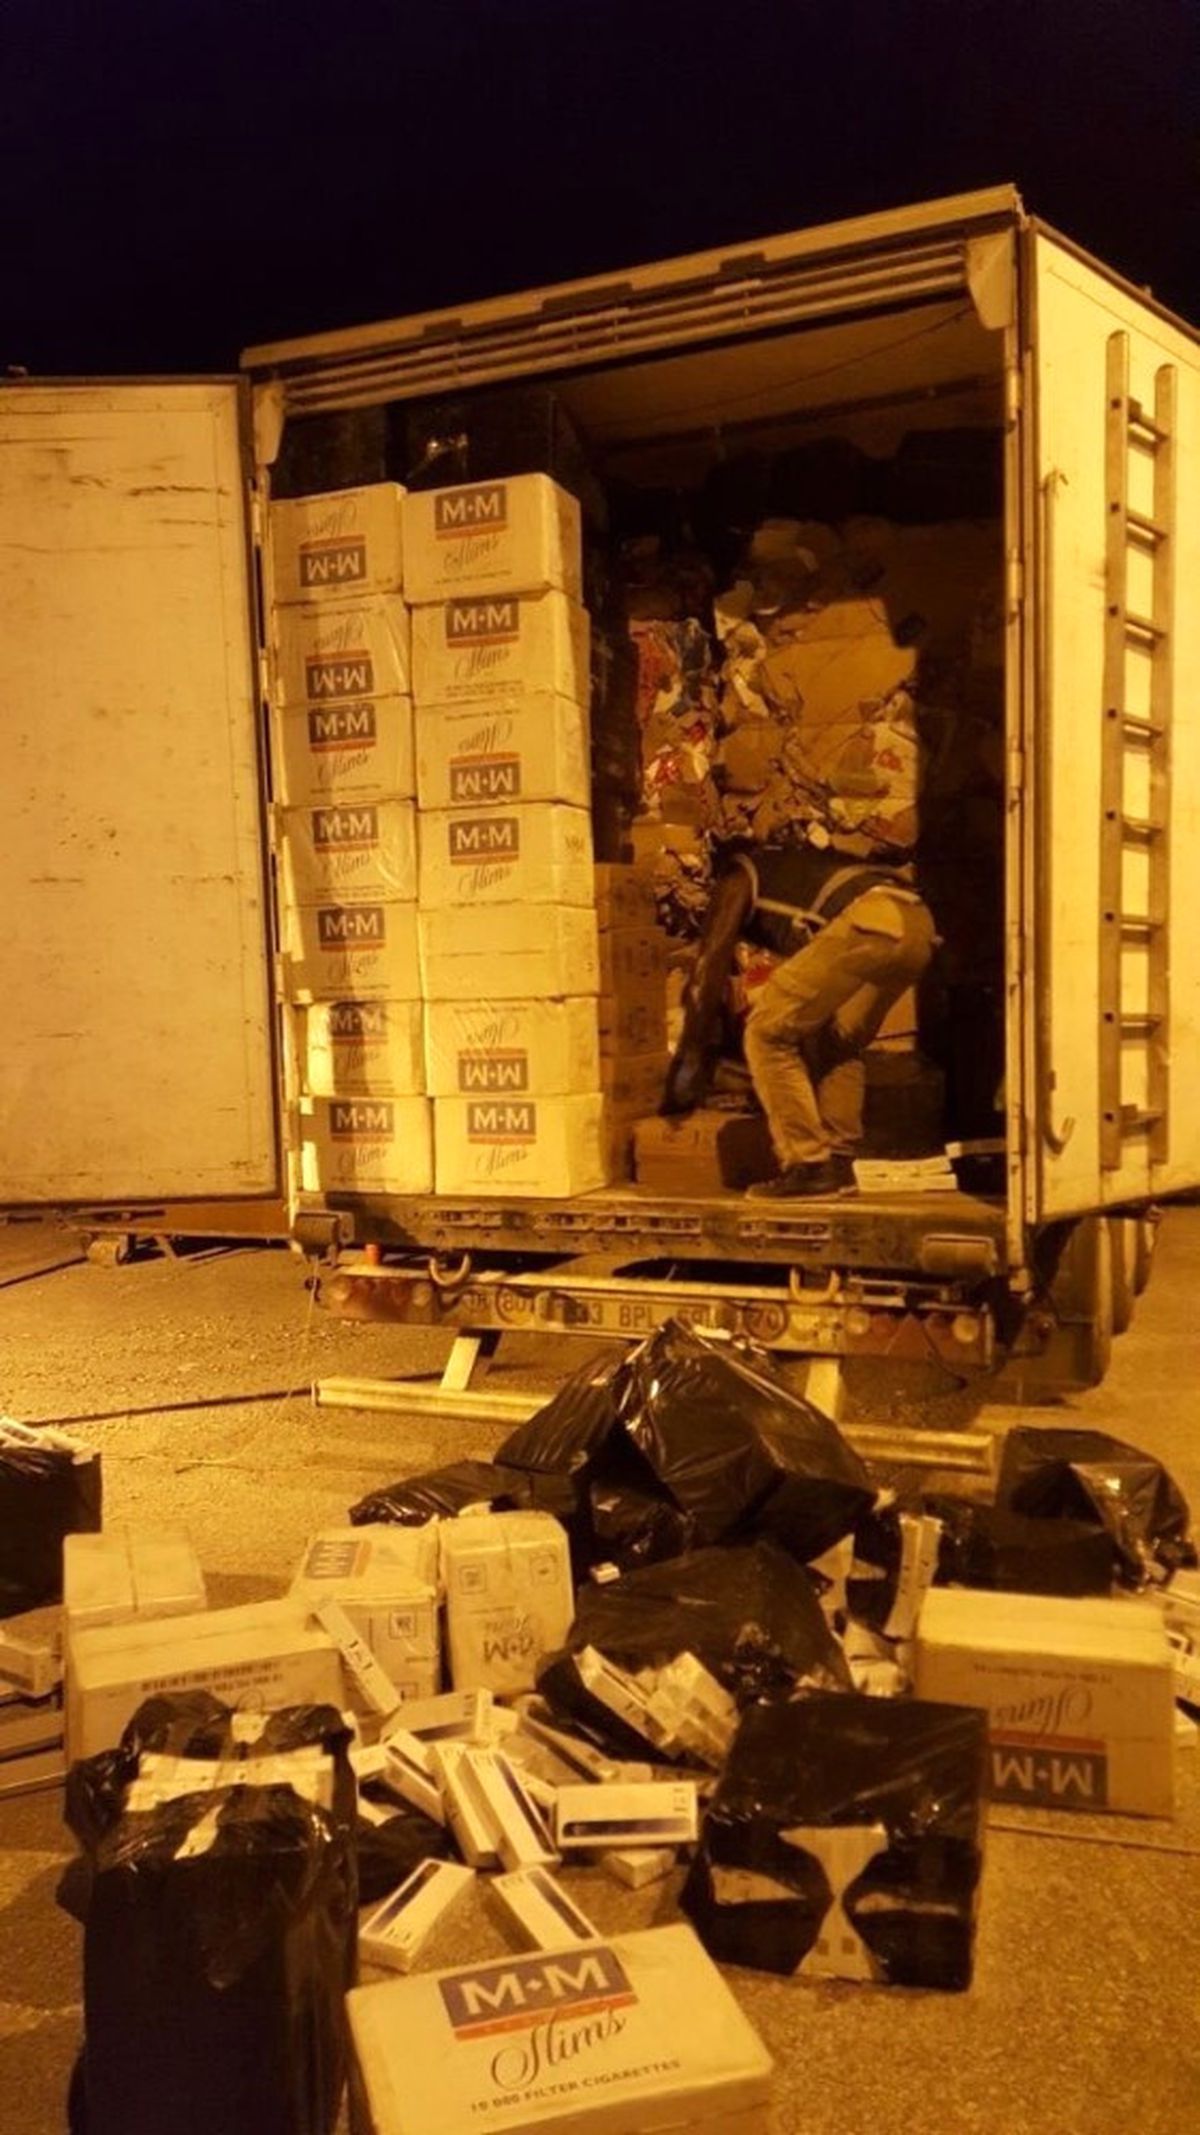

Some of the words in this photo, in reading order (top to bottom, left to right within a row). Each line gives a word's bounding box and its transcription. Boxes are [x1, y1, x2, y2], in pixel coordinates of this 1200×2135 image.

[619, 1304, 657, 1329] BPL
[491, 2006, 627, 2091] Slims
[525, 2081, 578, 2102] FILTER
[582, 2060, 680, 2088] CIGARETTES
